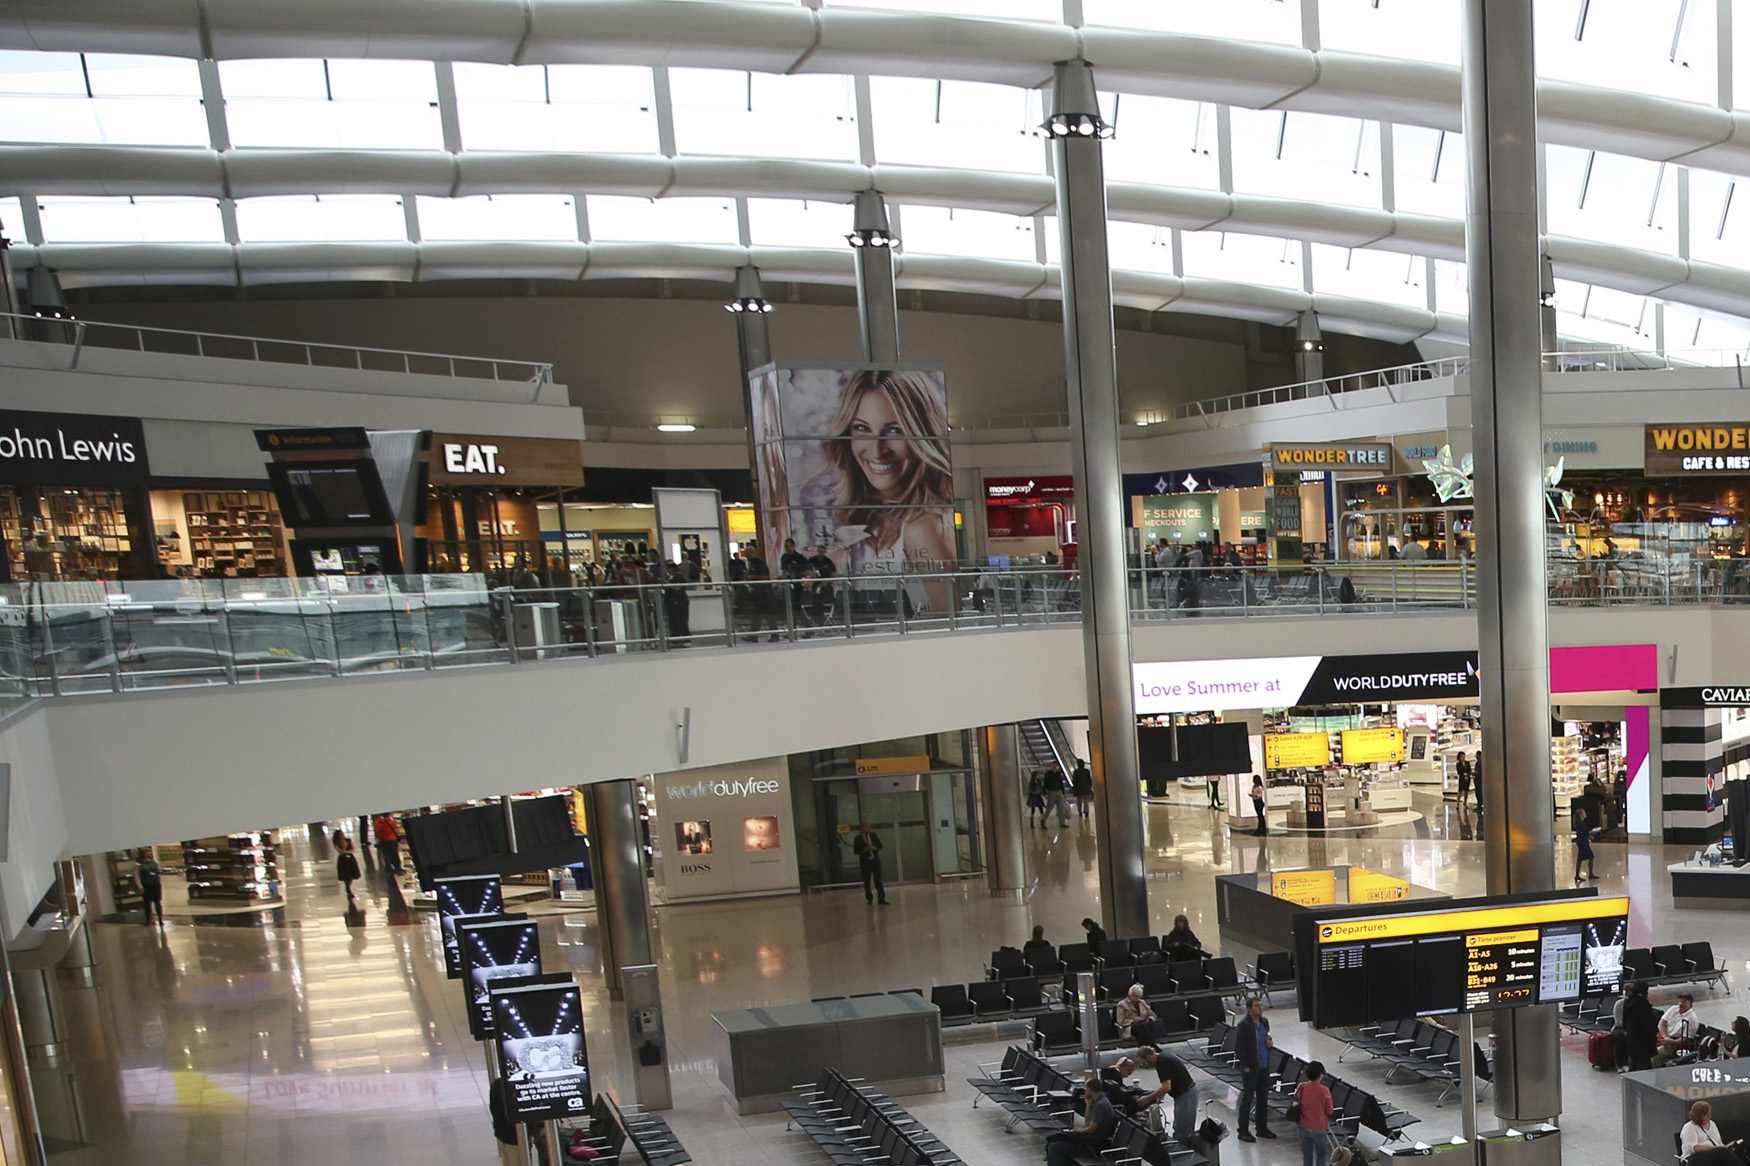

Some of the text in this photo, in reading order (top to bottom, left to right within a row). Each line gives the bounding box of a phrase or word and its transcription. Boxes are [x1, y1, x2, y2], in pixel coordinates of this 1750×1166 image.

[0, 427, 136, 463] ohn Lewis
[444, 442, 506, 475] EAT.
[1277, 449, 1387, 465] WONDERTREE
[1682, 457, 1712, 470] CAFE
[1714, 456, 1724, 469] &
[1153, 508, 1202, 519] SERVICE
[1144, 519, 1187, 527] HECKOUTS
[1240, 516, 1263, 526] ERE
[1140, 679, 1281, 697] Love Summer at
[1333, 672, 1467, 690] WORLDDUTYFREE
[680, 864, 711, 873] BOSS
[1335, 924, 1388, 935] Departures
